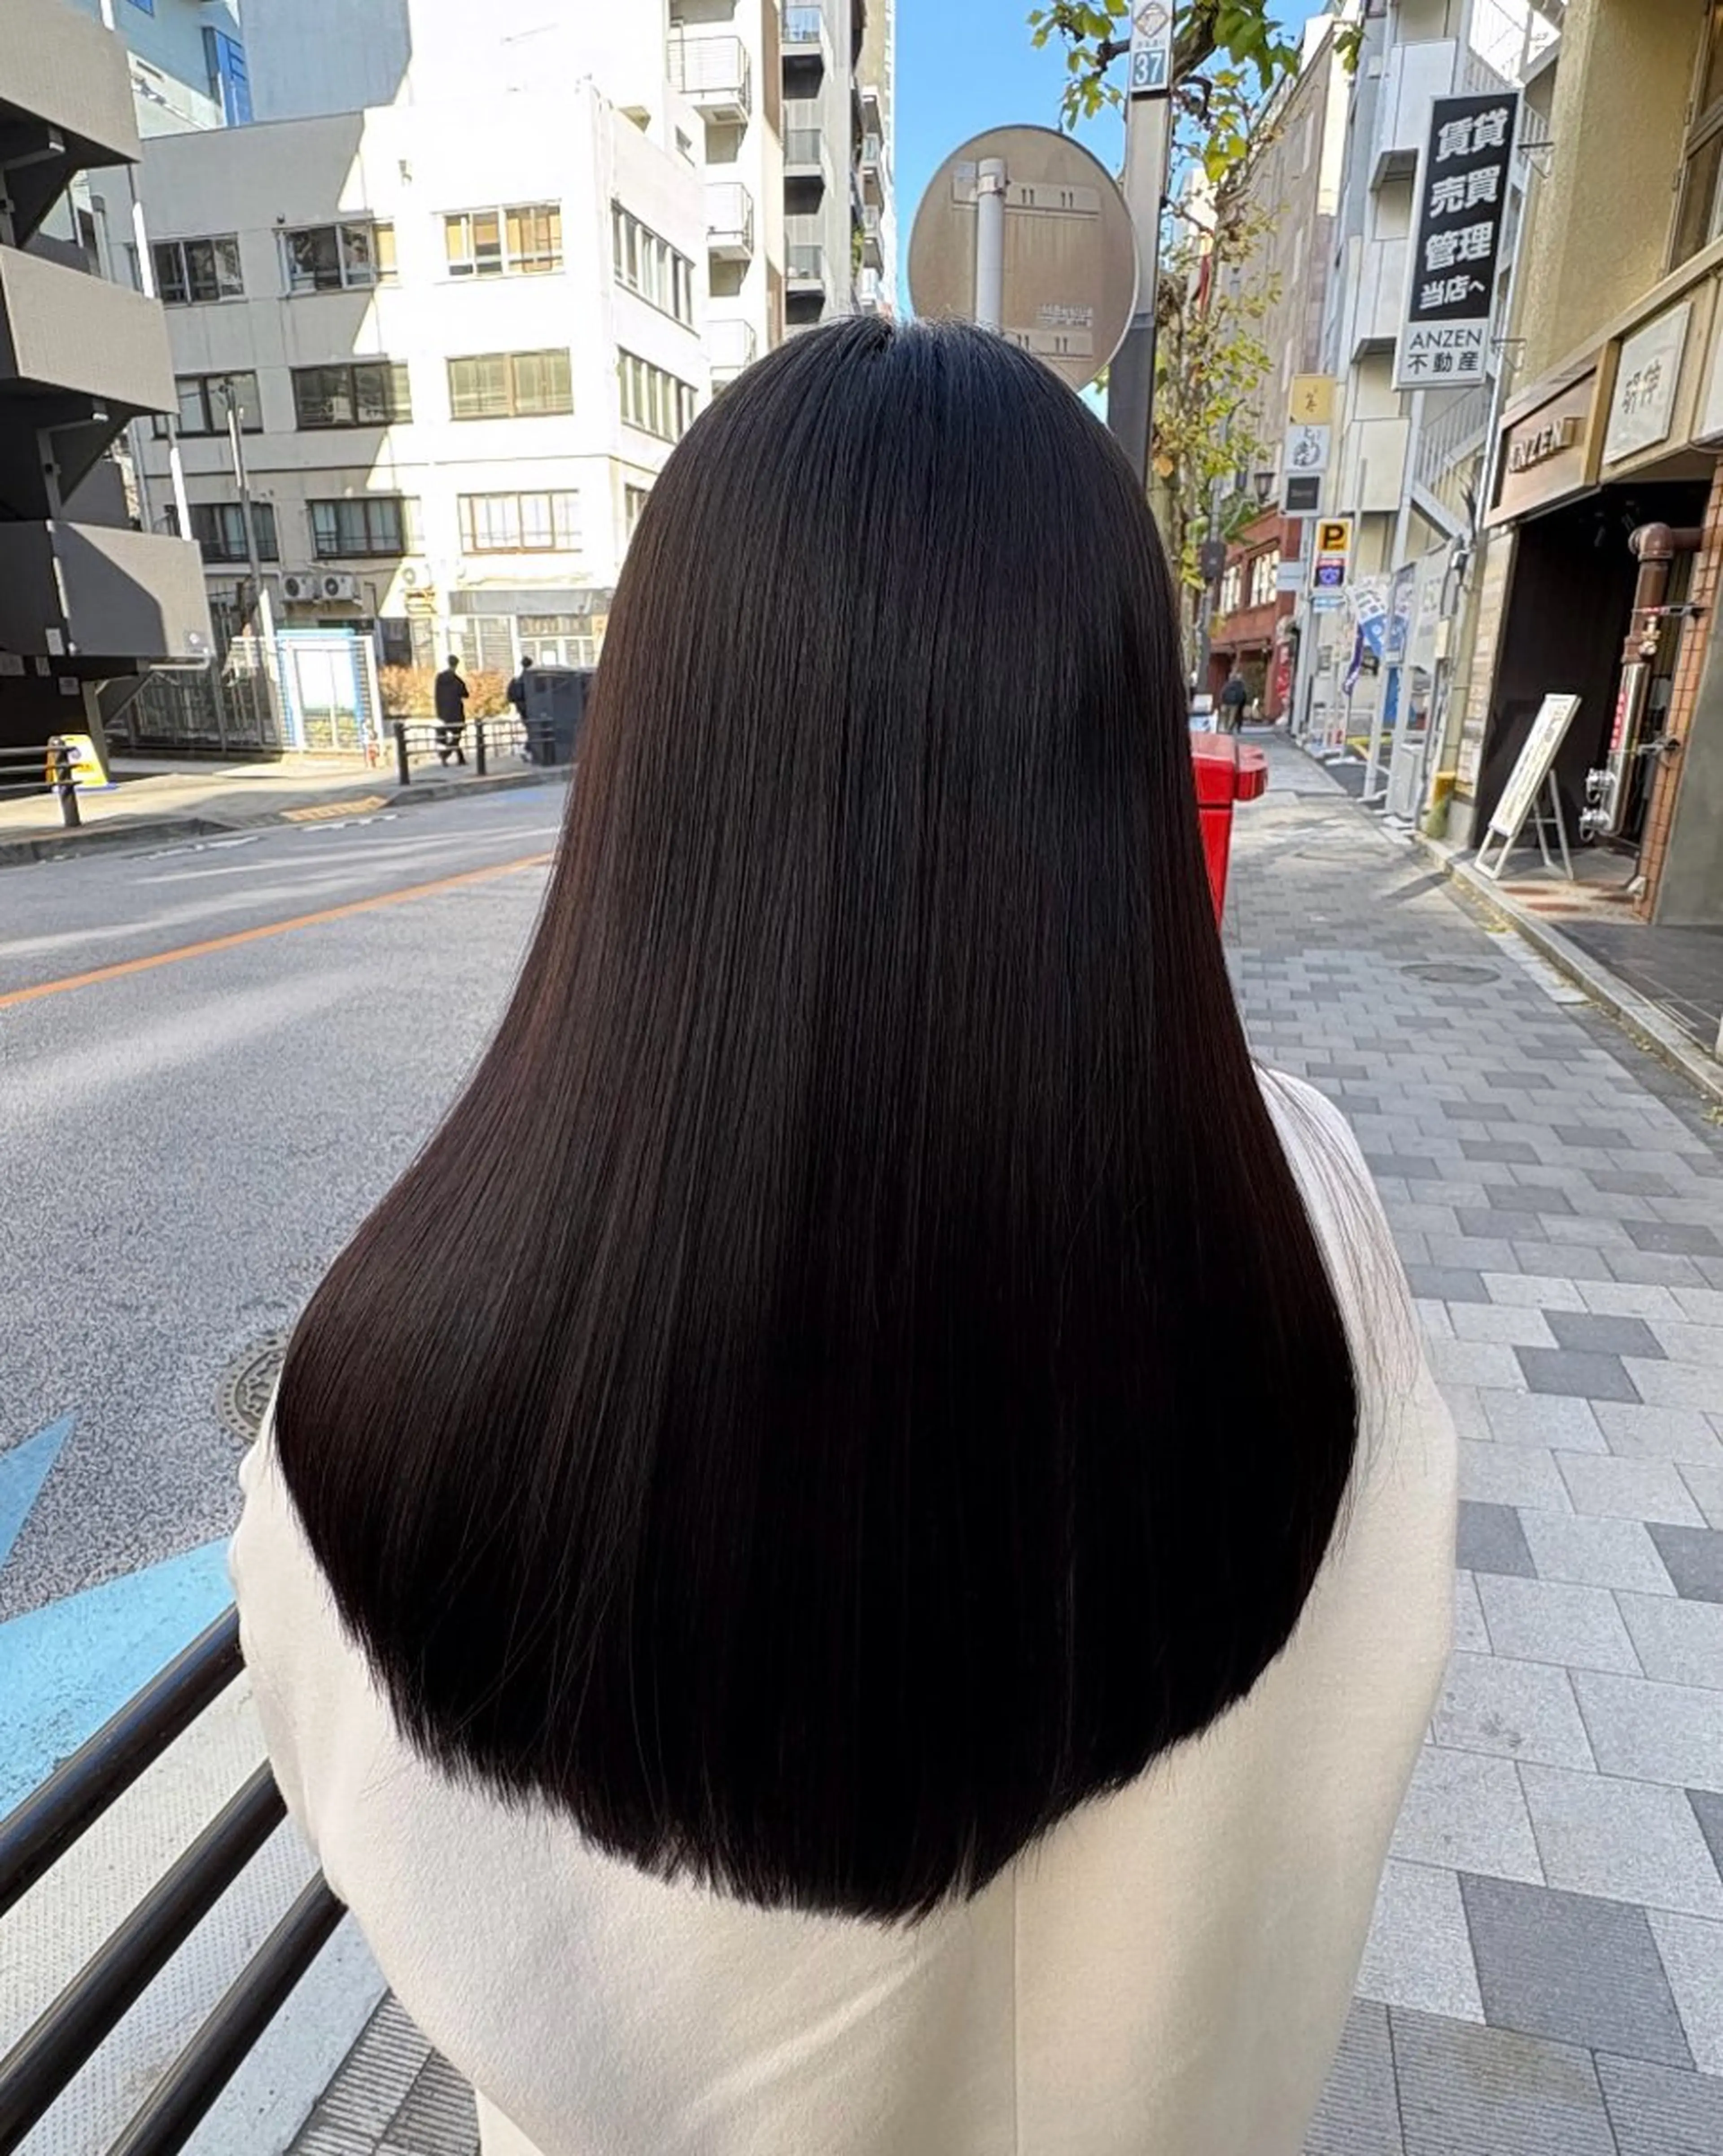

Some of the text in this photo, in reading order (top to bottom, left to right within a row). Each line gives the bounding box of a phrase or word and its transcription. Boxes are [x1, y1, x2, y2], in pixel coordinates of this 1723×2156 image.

[1135, 53, 1162, 84] 37
[1436, 107, 1508, 162] 賃貸
[1430, 165, 1501, 219] 売買
[1426, 222, 1494, 272] 管理
[1419, 275, 1486, 310] 当店へ
[1409, 328, 1482, 350] ANZEN
[1407, 351, 1478, 375] 不動産
[1323, 524, 1345, 550] P
